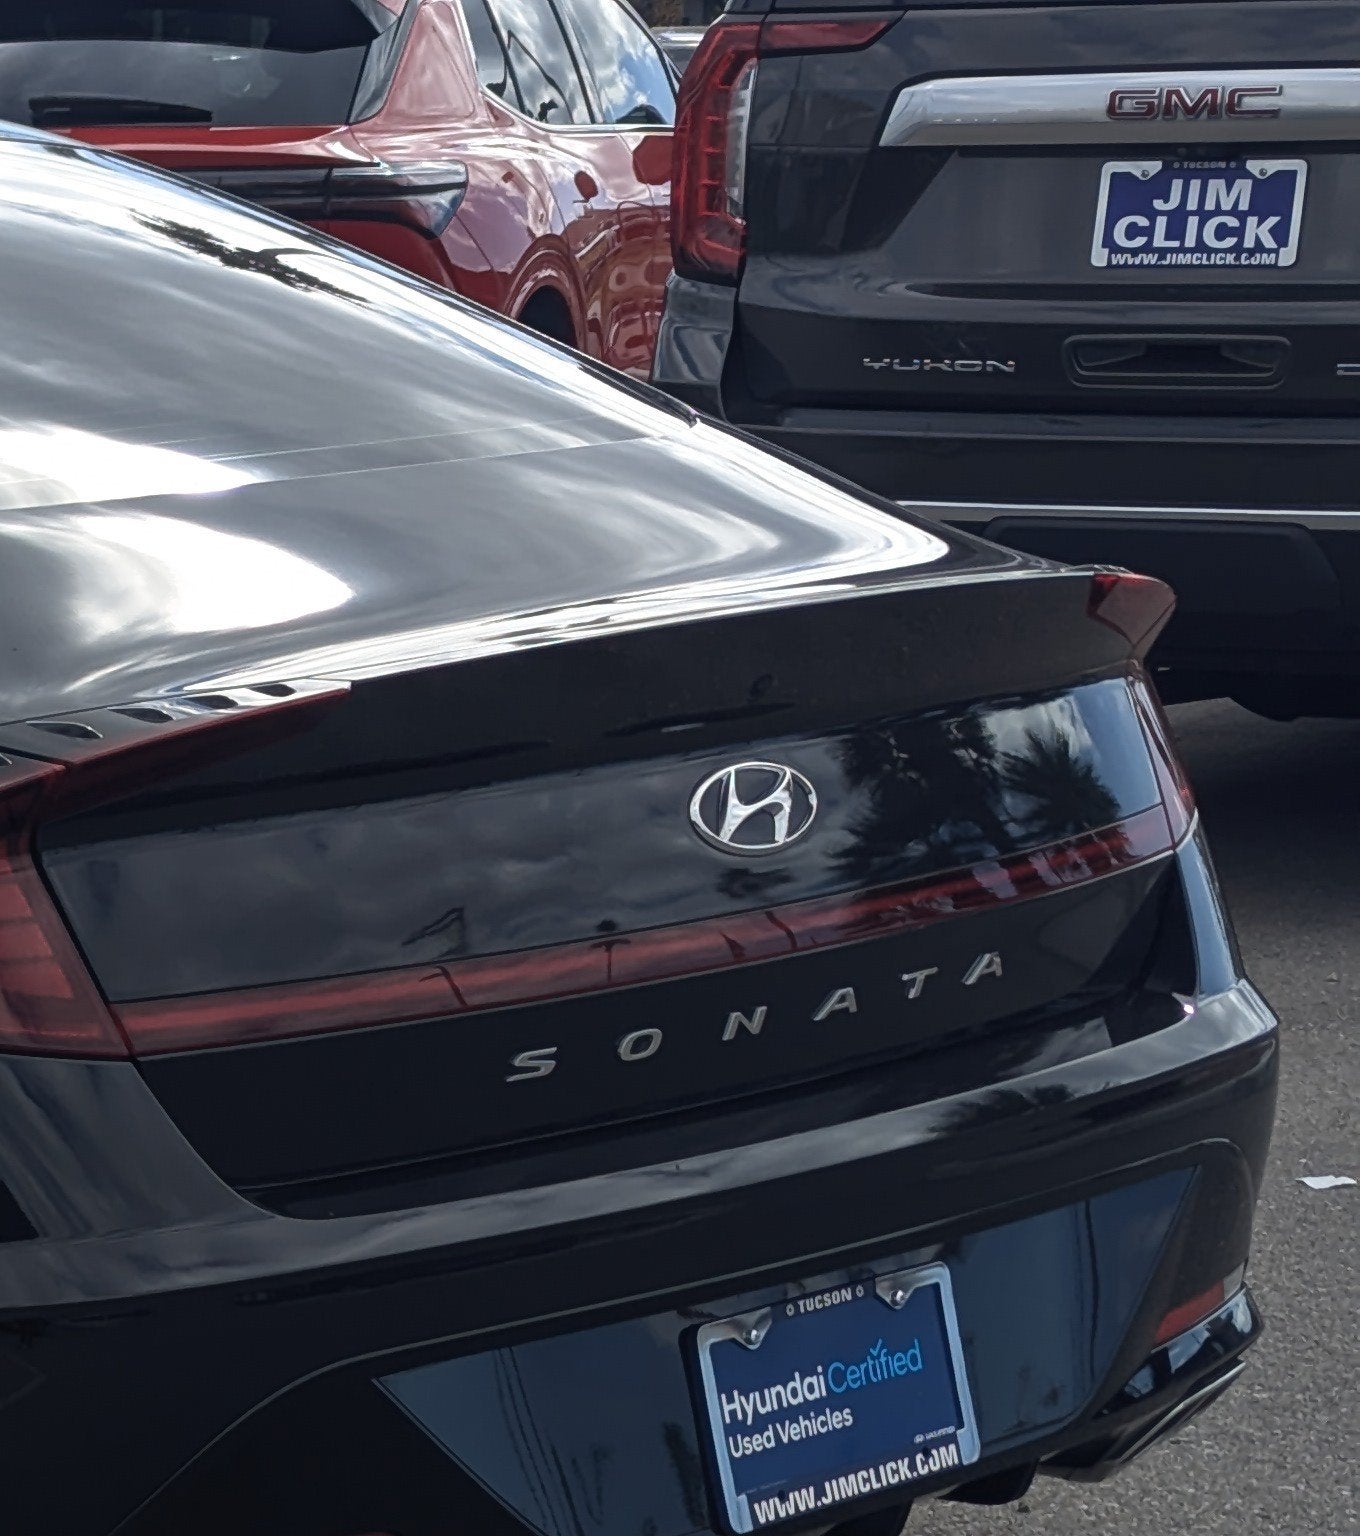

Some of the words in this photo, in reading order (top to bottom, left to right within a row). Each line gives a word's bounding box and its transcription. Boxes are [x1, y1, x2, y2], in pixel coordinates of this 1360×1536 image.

[1105, 85, 1283, 121] GMC
[1152, 178, 1253, 211] JIM
[1113, 215, 1282, 249] CLICK
[1111, 252, 1276, 265] WWW.JIMCLICK.COM
[862, 357, 1016, 373] YUKON
[505, 950, 1004, 1083] SONATA
[797, 1287, 852, 1314] TUCSON
[720, 1365, 828, 1426] Hyundai
[827, 1338, 923, 1394] Certified
[728, 1425, 776, 1459] Used
[775, 1405, 854, 1446] Vehicles
[753, 1443, 959, 1525] WWW.JIMCLICK.COM
